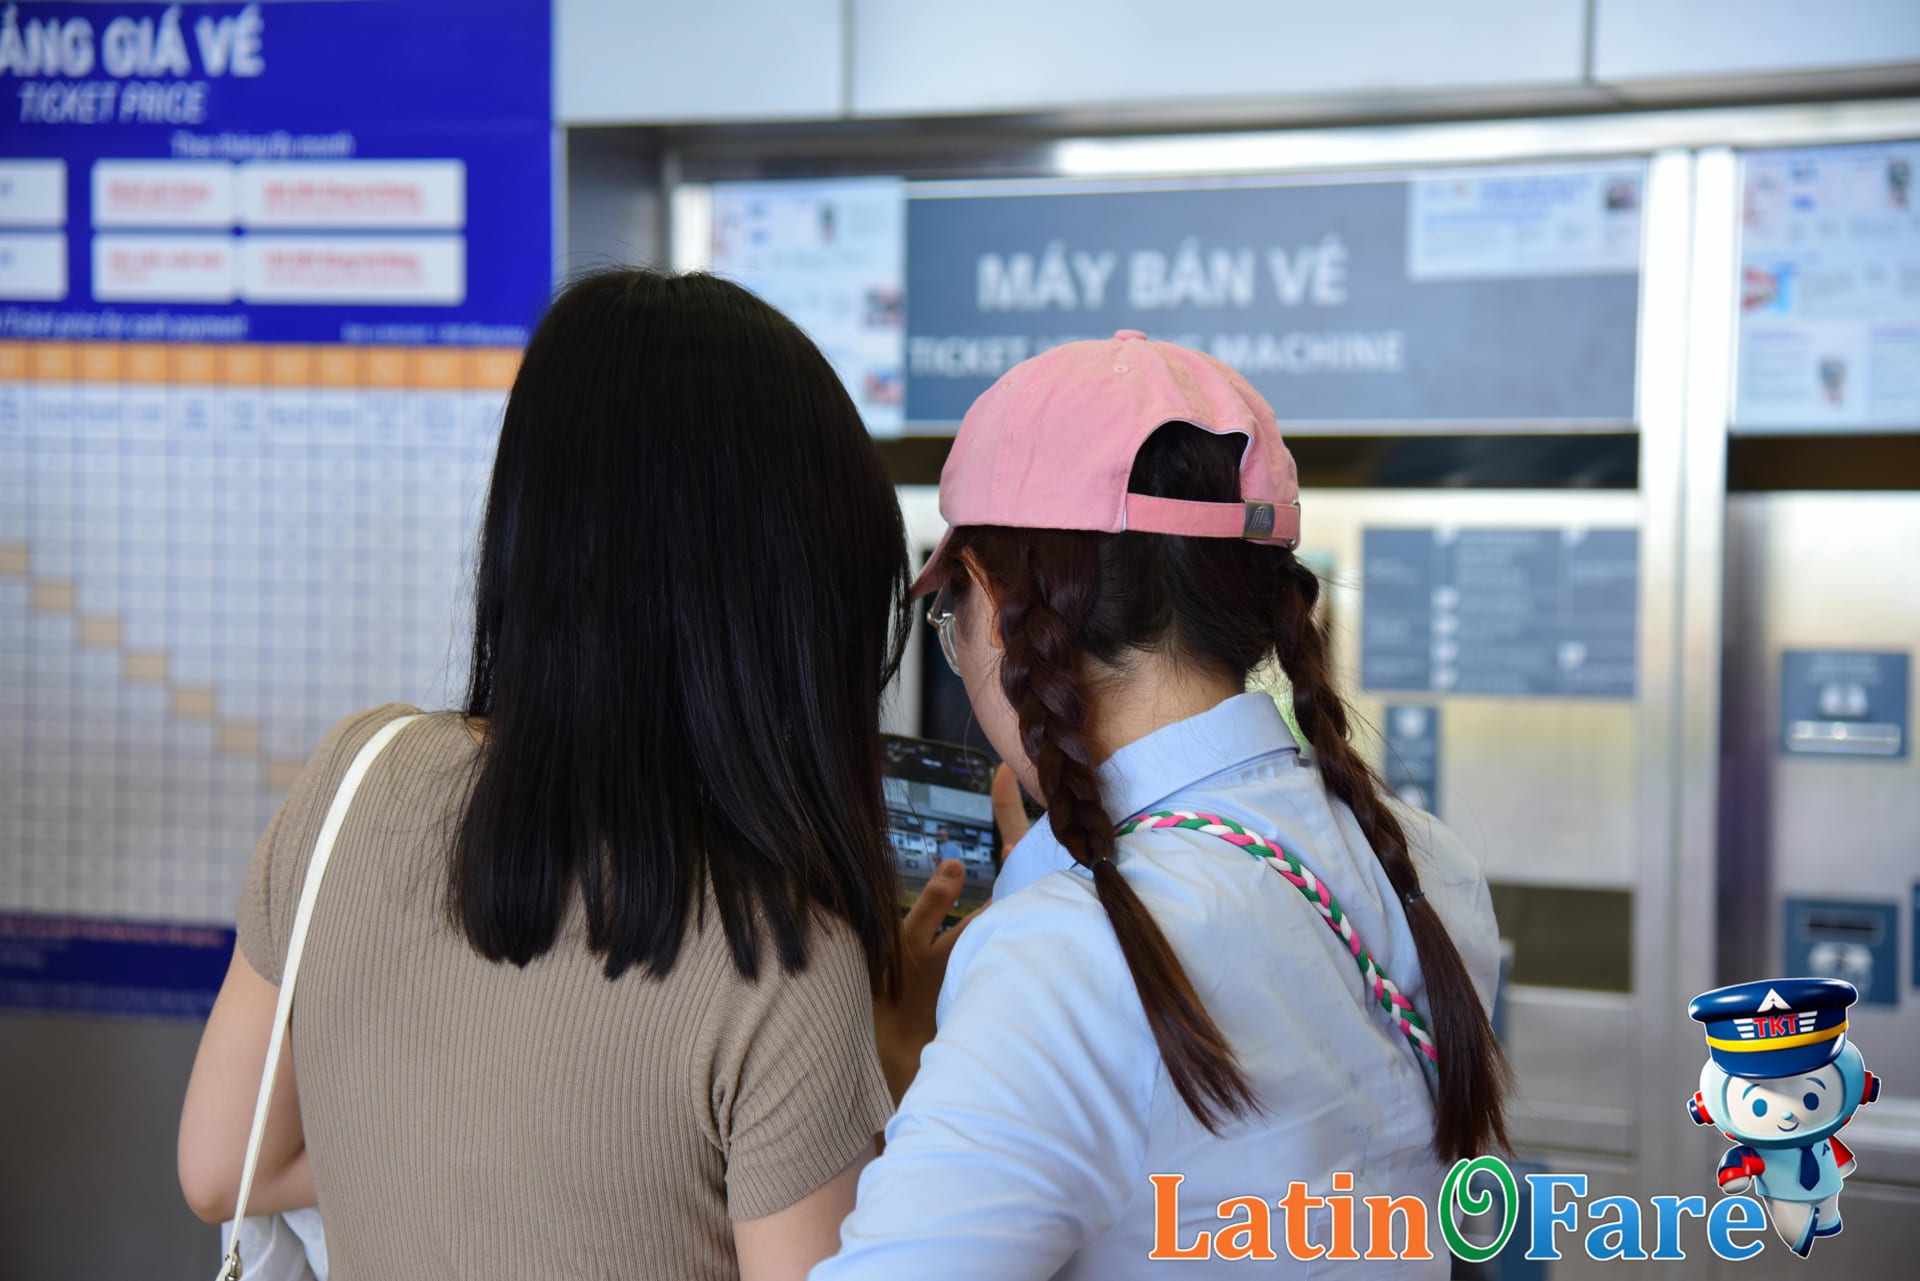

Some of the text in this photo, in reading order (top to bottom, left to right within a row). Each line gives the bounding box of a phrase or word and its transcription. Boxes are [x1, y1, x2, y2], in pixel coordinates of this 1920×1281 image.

[102, 3, 191, 78] GIÁ
[193, 3, 266, 77] VÉ
[17, 80, 210, 125] TICKET PRICE
[977, 231, 1348, 312] MÁY BÁN VÉ
[1211, 330, 1407, 373] MACHINE
